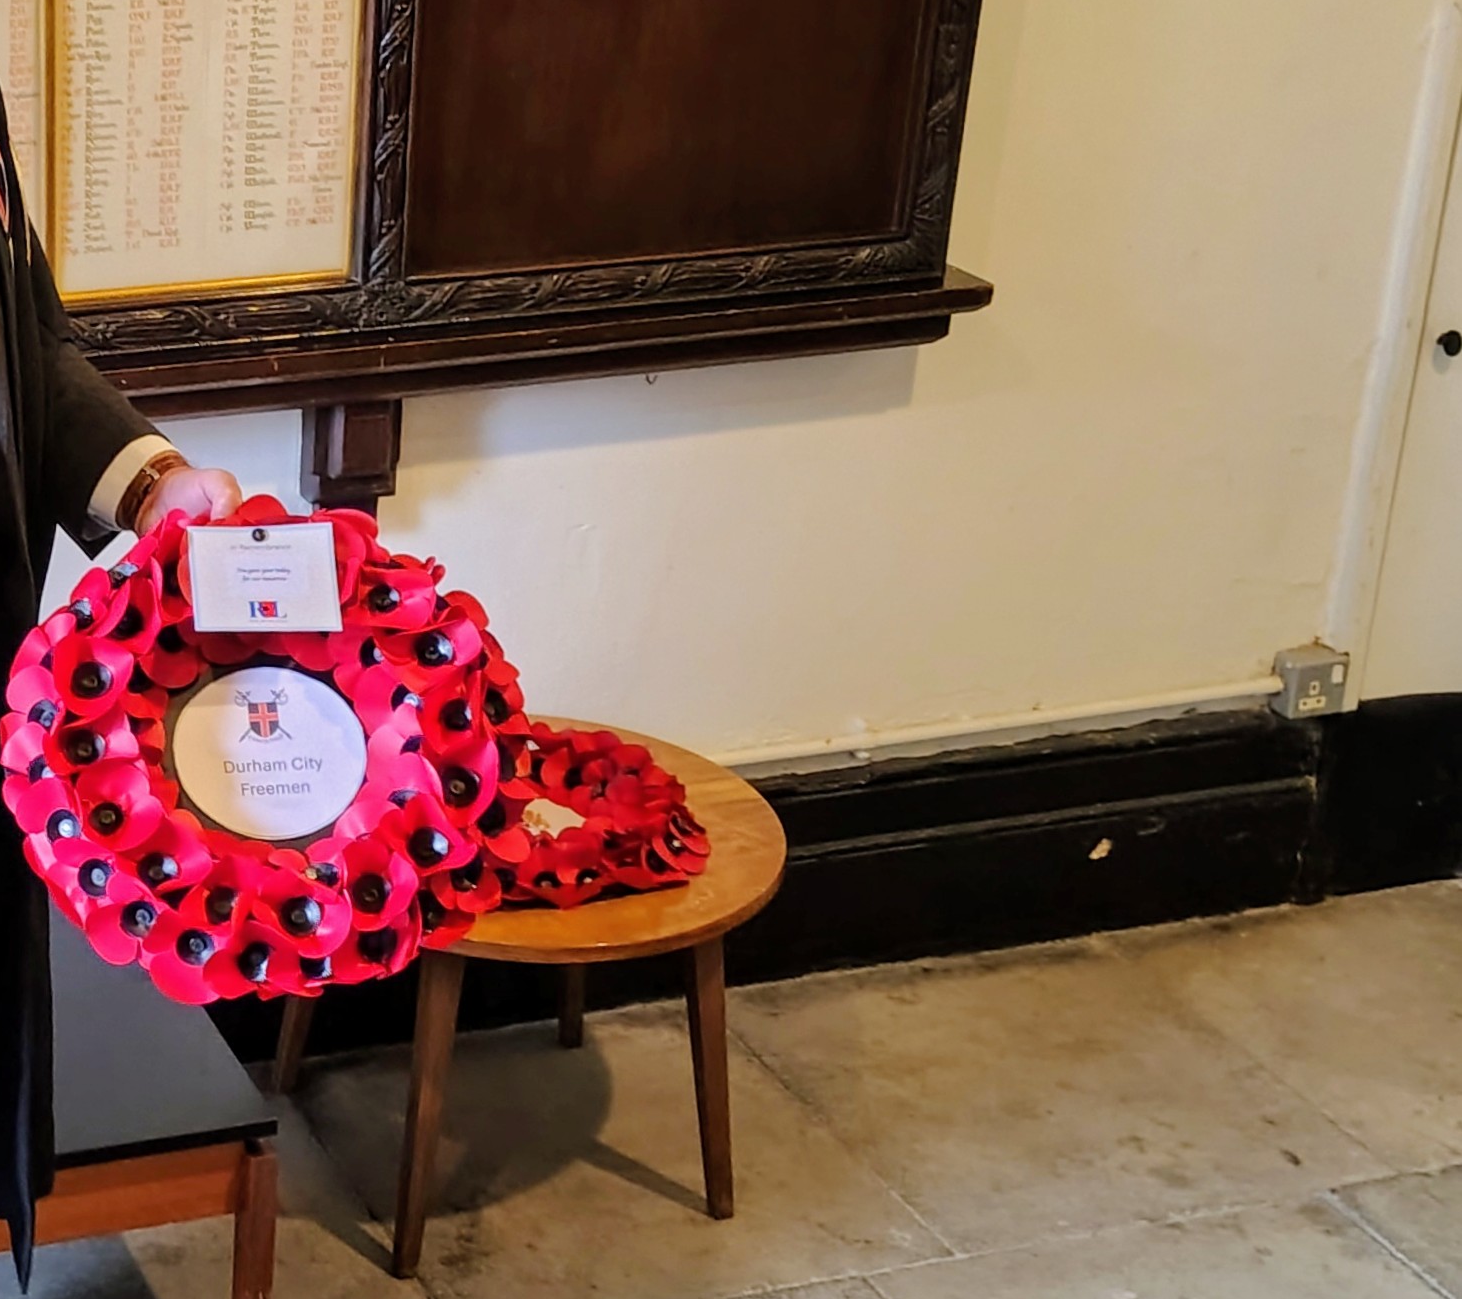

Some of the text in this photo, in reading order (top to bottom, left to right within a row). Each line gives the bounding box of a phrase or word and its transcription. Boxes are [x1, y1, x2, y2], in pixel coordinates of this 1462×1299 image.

[223, 756, 323, 775] Durham City
[240, 781, 311, 797] Freemen
